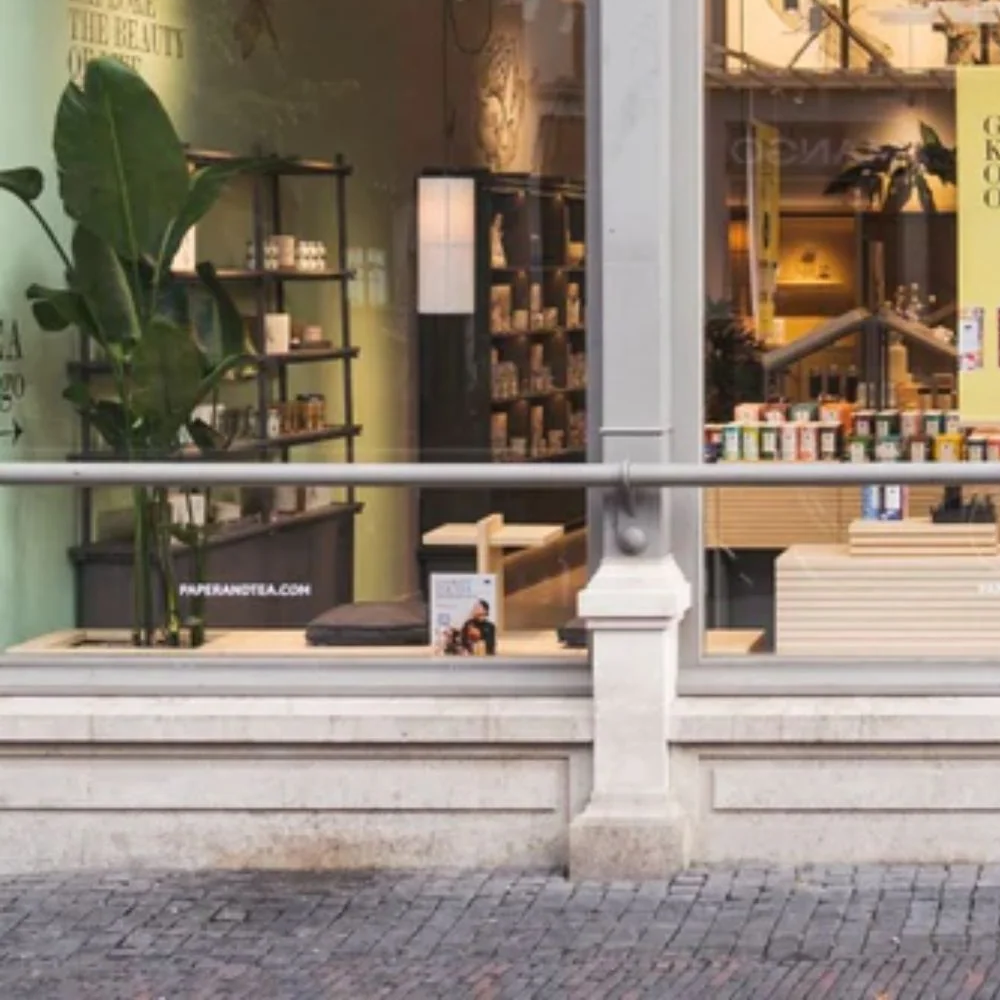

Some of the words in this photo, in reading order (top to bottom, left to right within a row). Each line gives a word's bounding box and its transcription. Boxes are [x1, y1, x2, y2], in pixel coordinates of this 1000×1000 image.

[68, 7, 108, 45] THE
[113, 15, 186, 59] BEAUTY
[179, 582, 311, 597] PAPERANDTEA.COM
